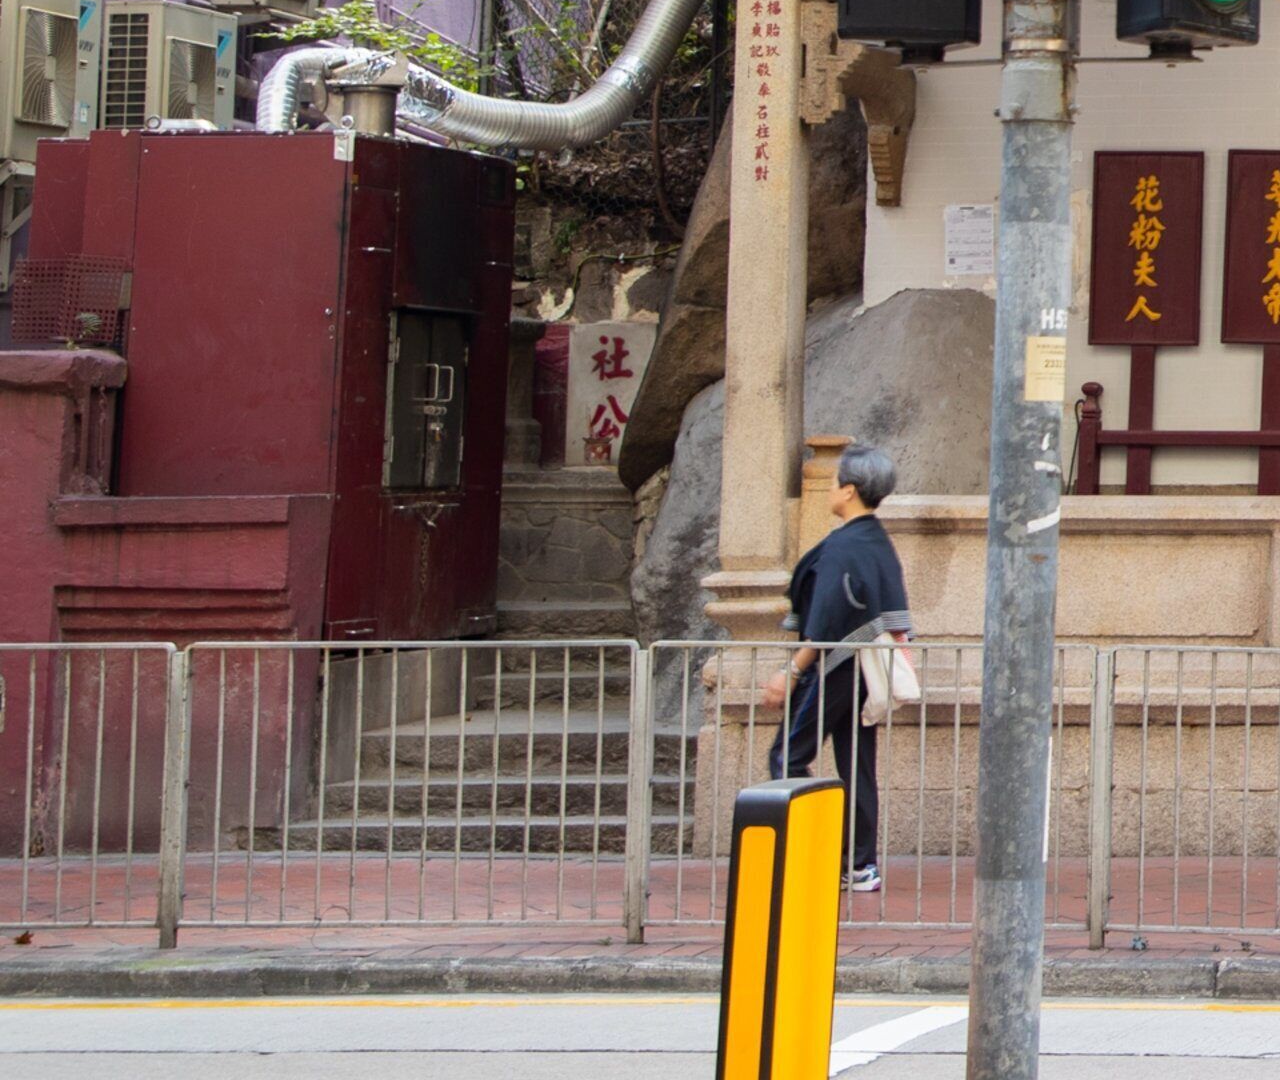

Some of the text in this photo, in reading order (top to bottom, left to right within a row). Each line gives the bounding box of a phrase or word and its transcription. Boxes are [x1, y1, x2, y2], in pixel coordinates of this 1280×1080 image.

[1124, 176, 1166, 323] 花粉夫人
[1041, 308, 1068, 329] H5
